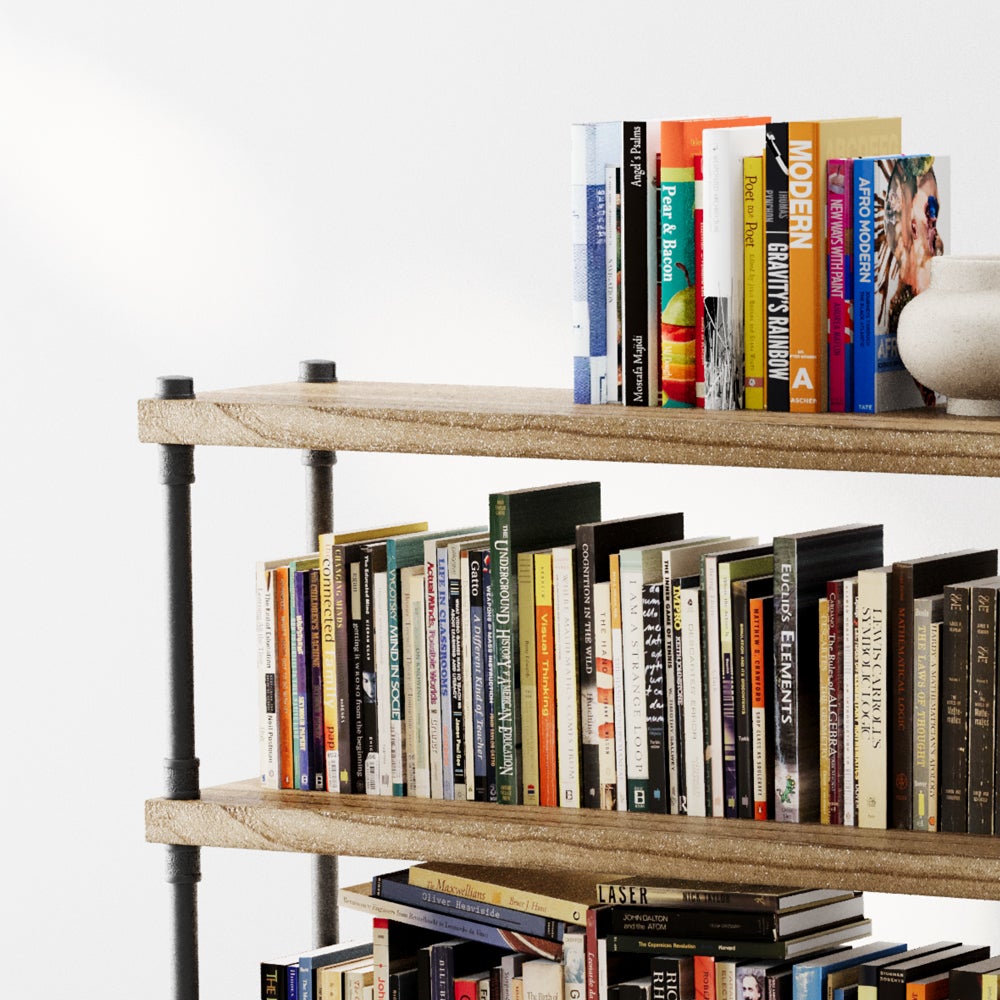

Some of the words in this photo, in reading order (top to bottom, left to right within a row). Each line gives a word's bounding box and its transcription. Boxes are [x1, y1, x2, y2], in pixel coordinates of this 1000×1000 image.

[631, 126, 642, 155] Psalms
[631, 157, 644, 187] Angel's
[745, 176, 757, 201] Poet
[663, 185, 676, 221] Pear
[789, 140, 812, 249] MODERN
[830, 199, 842, 219] NEW
[858, 178, 869, 217] AFRO
[663, 224, 675, 236] &
[745, 222, 757, 247] Poet
[830, 221, 842, 244] WAYS
[663, 240, 676, 281] Bacon
[831, 246, 842, 269] WITH
[859, 220, 870, 282] MODERN
[767, 243, 788, 312] GRAVITY'S
[831, 270, 843, 298] PAINT
[631, 335, 644, 357] Majidi
[768, 317, 789, 380] RAINBOW
[633, 362, 643, 401] Mostafa
[792, 367, 813, 390] A
[471, 561, 480, 596] Gatto
[781, 564, 792, 622] EUCLID'S
[323, 559, 334, 642] connected
[541, 614, 549, 655] Visual
[917, 626, 926, 649] THE
[325, 650, 336, 708] family
[542, 660, 550, 716] Thinking
[781, 630, 794, 723] ELEMENTS
[917, 655, 926, 687] LAWS
[917, 693, 926, 705] OF
[917, 712, 926, 767] THOUGHT
